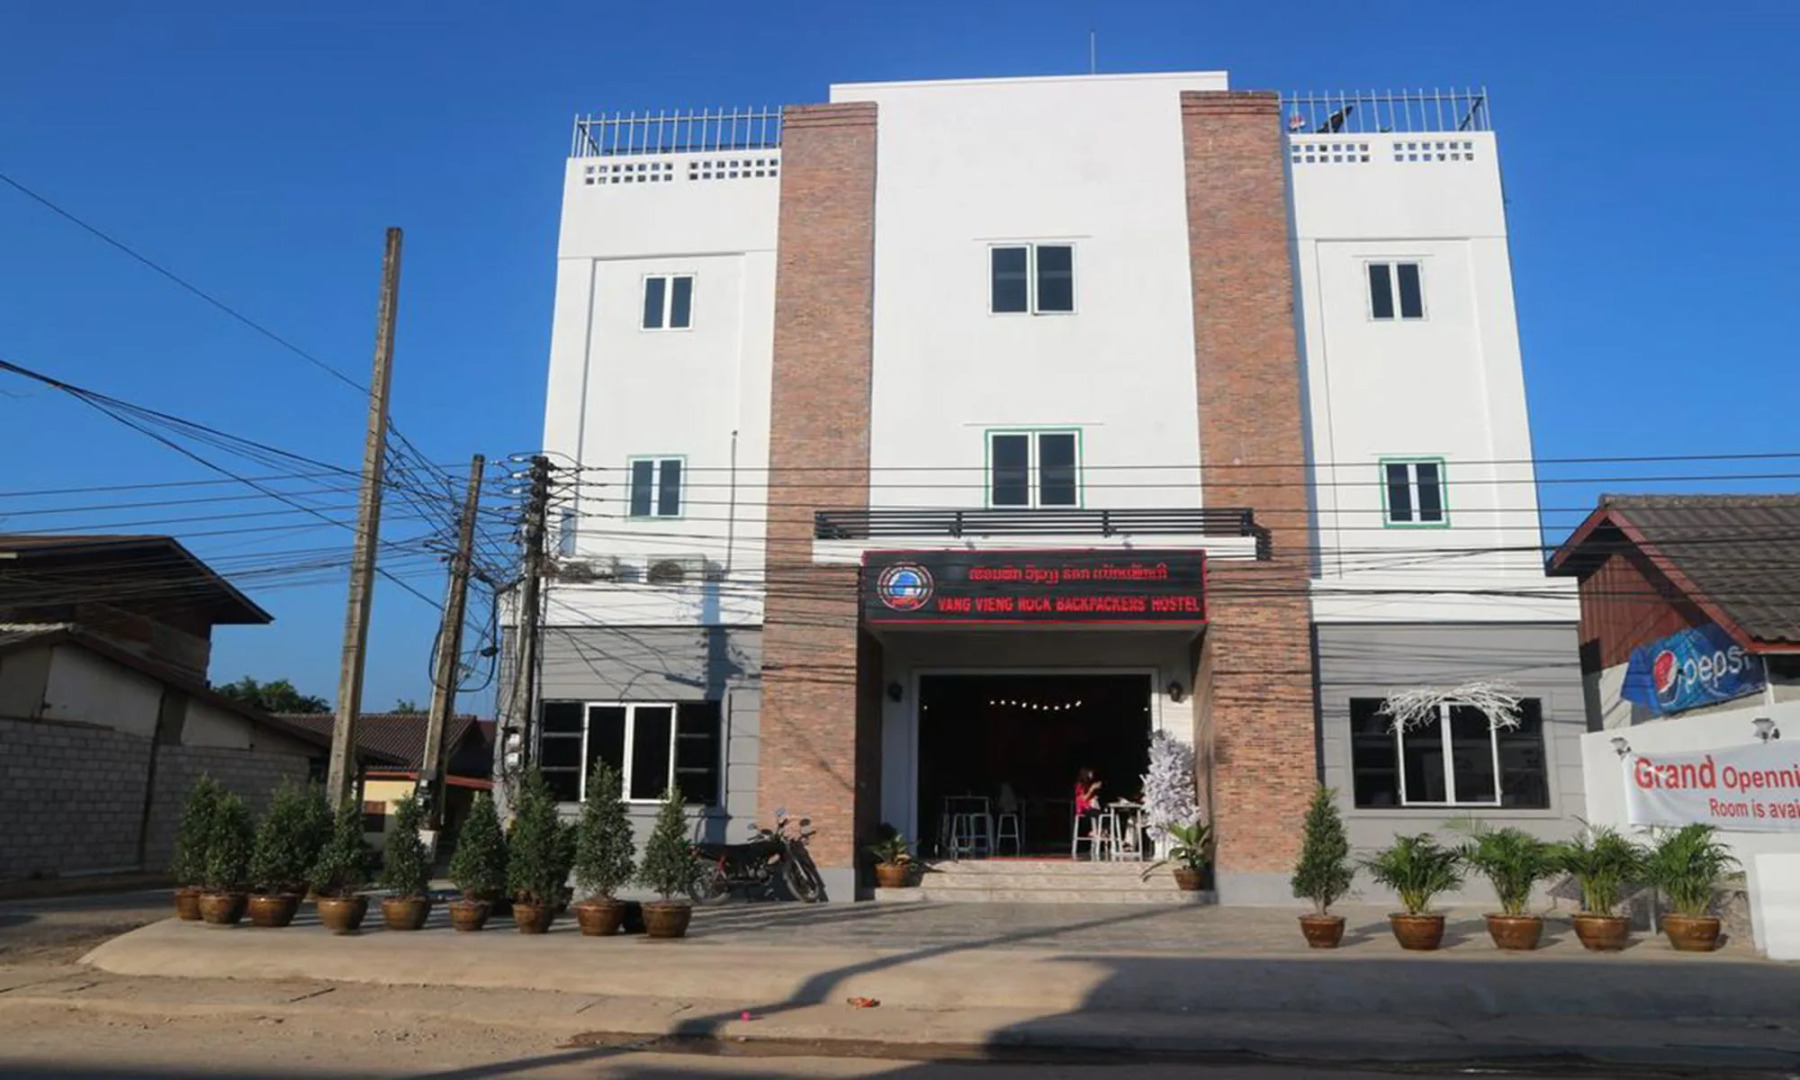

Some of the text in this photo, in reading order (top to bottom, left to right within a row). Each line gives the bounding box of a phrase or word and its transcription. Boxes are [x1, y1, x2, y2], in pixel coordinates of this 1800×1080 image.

[937, 596, 971, 612] VANG
[975, 596, 1013, 612] VIENG
[1151, 595, 1201, 612] HOSTEL
[1683, 645, 1751, 694] pepsi
[1634, 755, 1717, 789] Grand
[1709, 798, 1749, 818] Room
[1751, 798, 1766, 818] is
